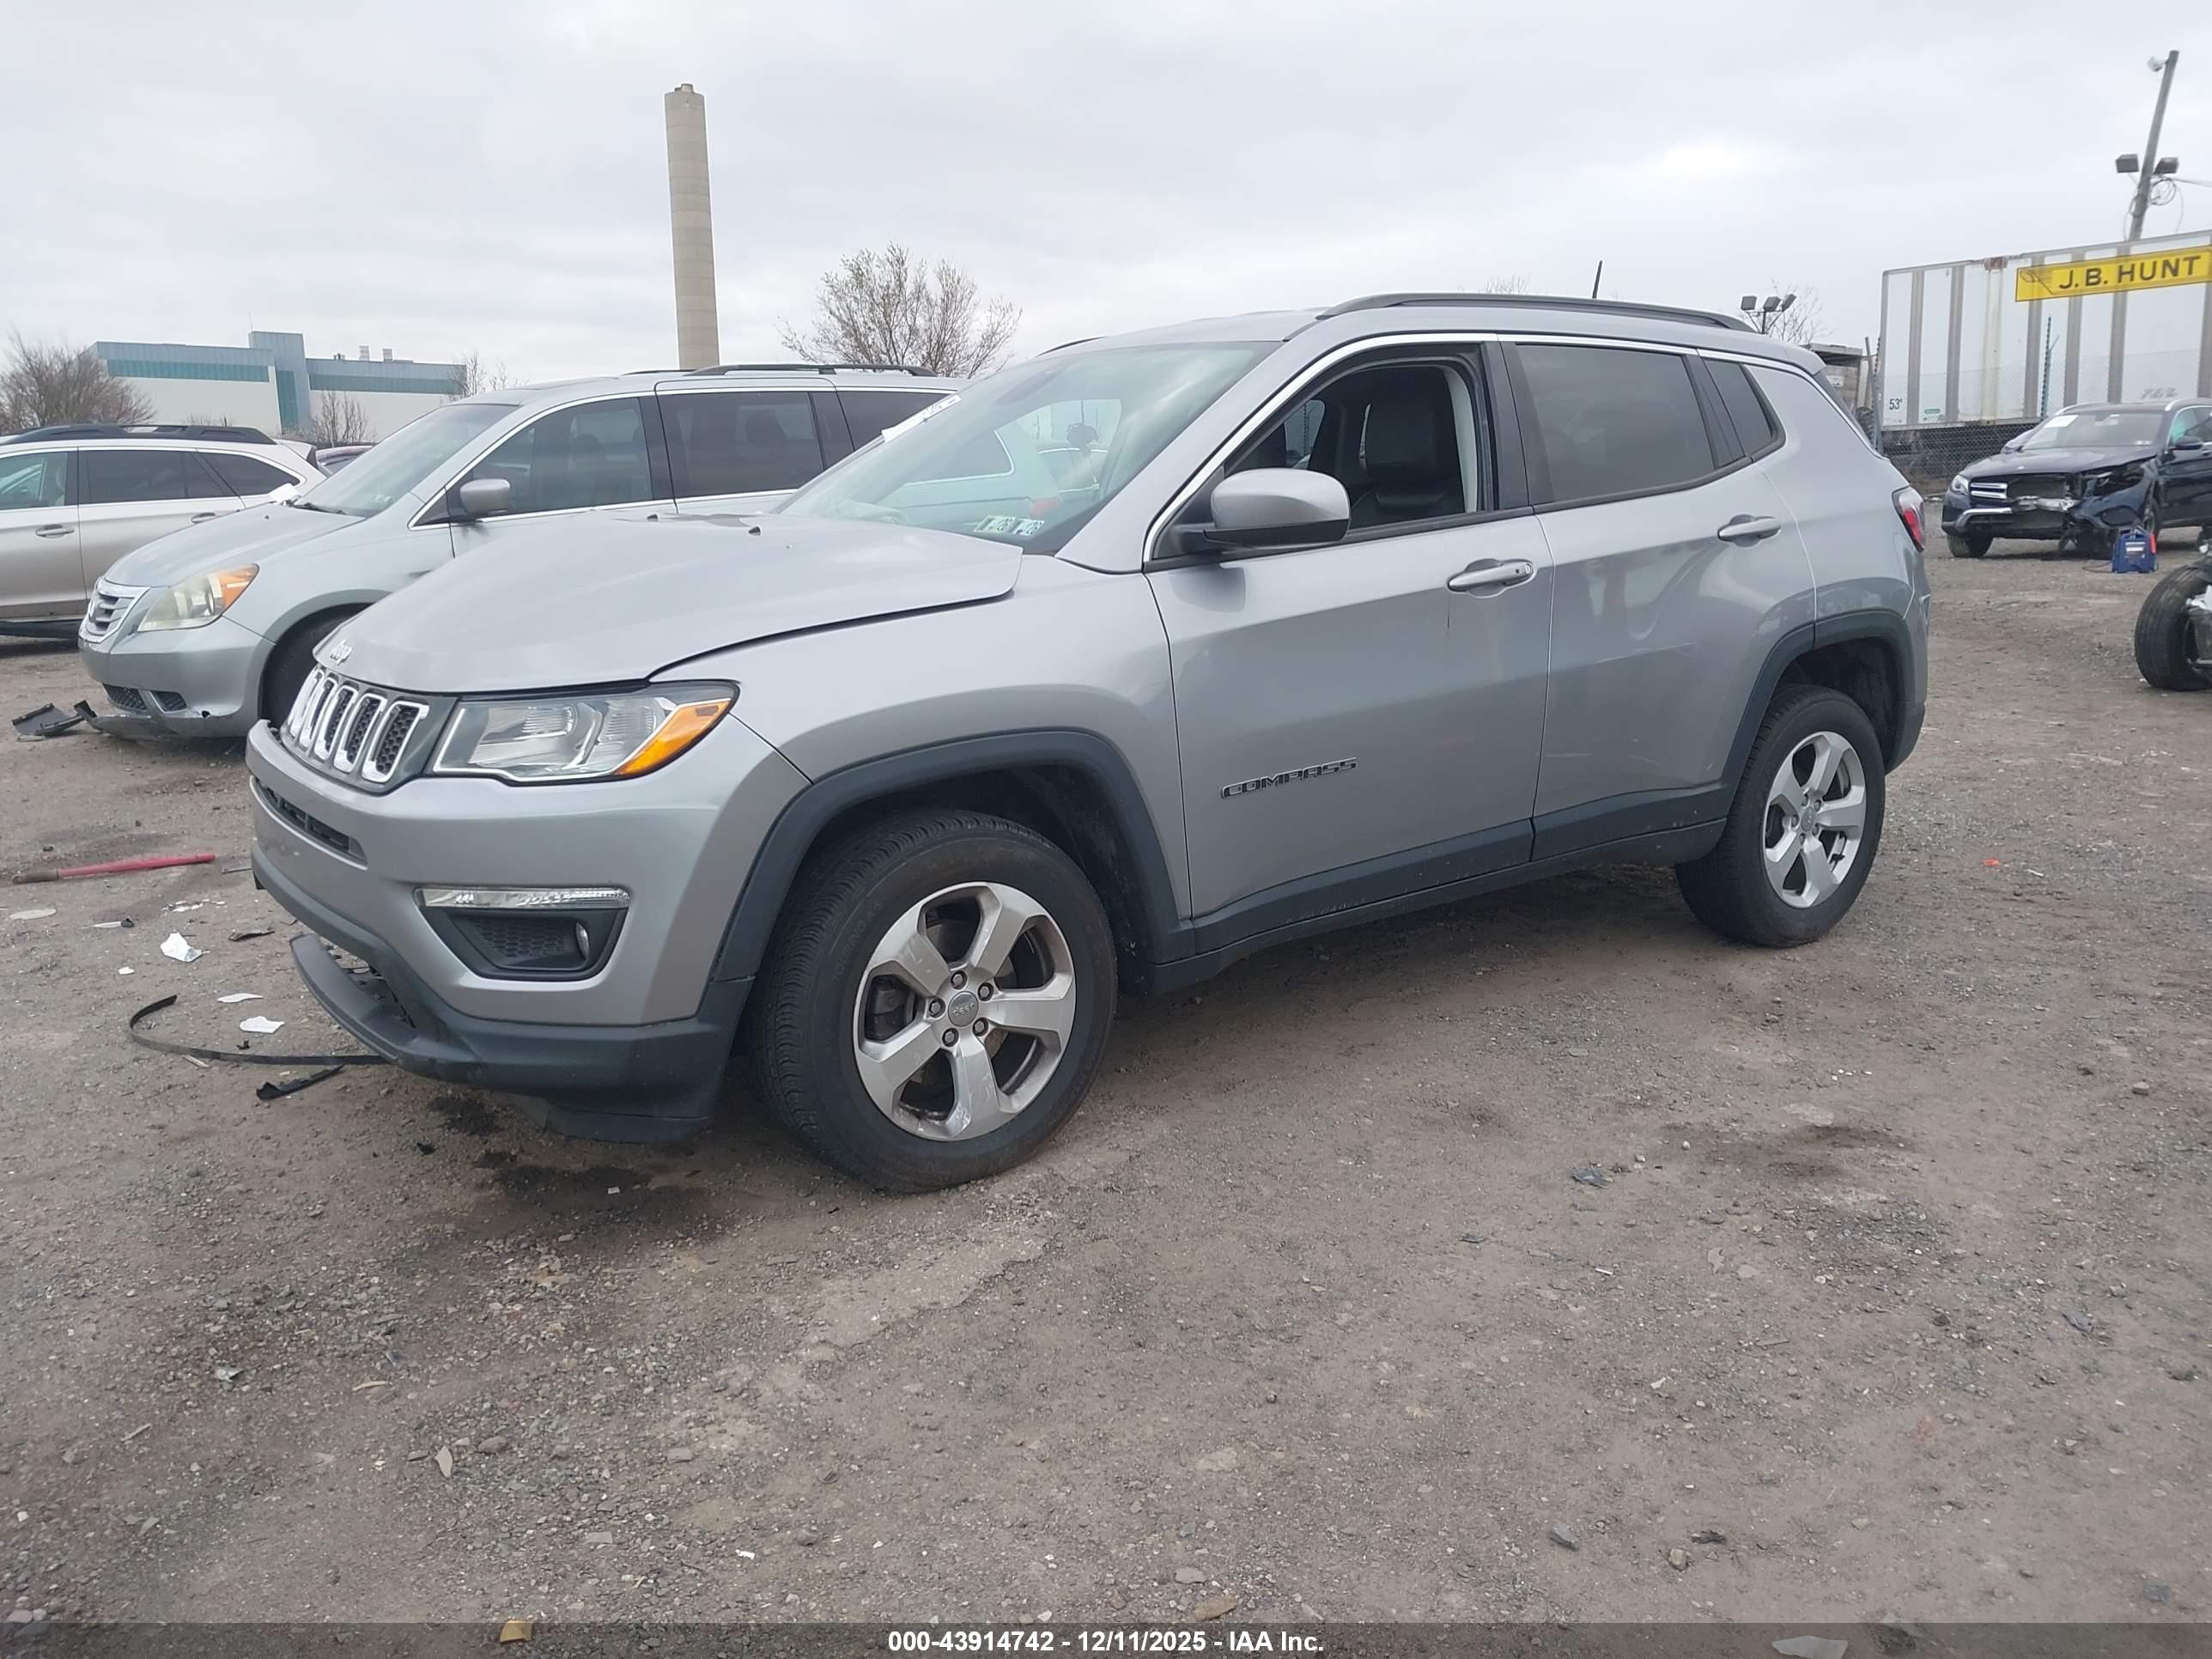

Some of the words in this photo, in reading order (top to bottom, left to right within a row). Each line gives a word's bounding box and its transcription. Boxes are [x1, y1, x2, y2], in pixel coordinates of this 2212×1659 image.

[2058, 266, 2109, 290] J.B.
[2118, 255, 2201, 283] HUNT
[1220, 757, 1358, 799] COMPASS
